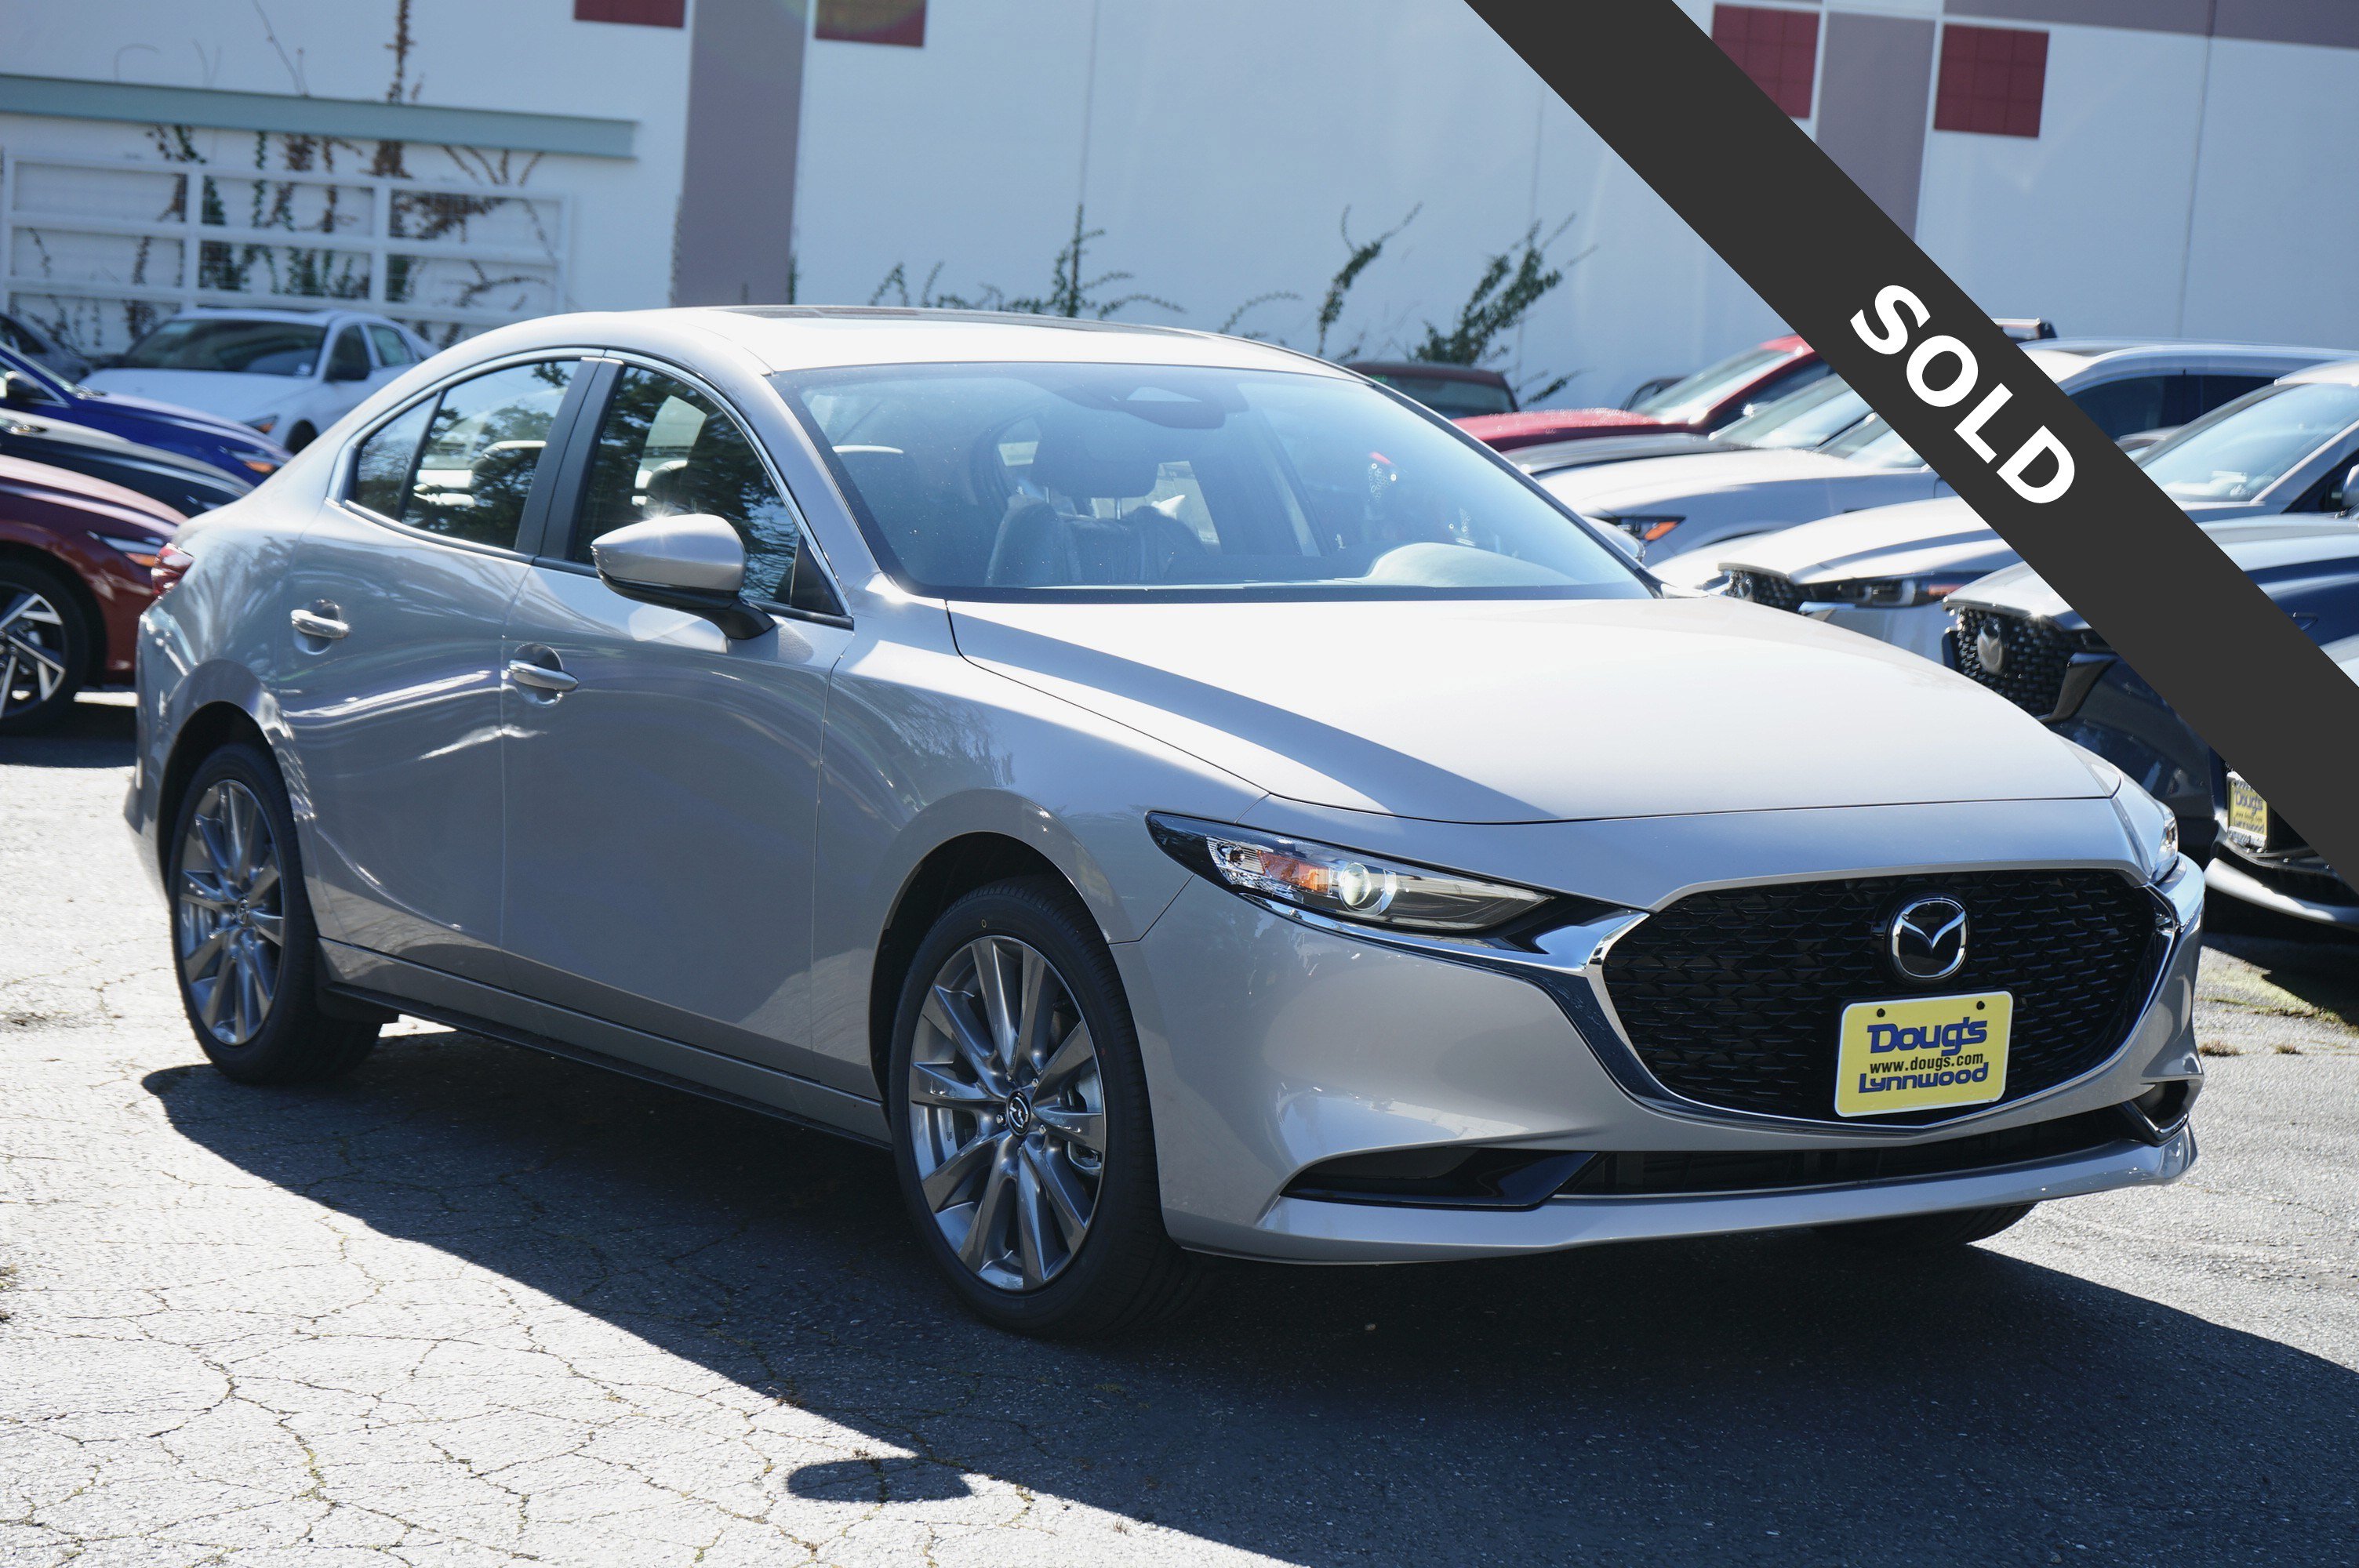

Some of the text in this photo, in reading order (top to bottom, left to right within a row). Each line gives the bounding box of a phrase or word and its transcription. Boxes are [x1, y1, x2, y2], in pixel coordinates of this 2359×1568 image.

[1866, 1016, 1988, 1057] Doug's
[1858, 1062, 1990, 1094] Lynnwood
[1870, 1053, 1984, 1074] www.dougs.com
